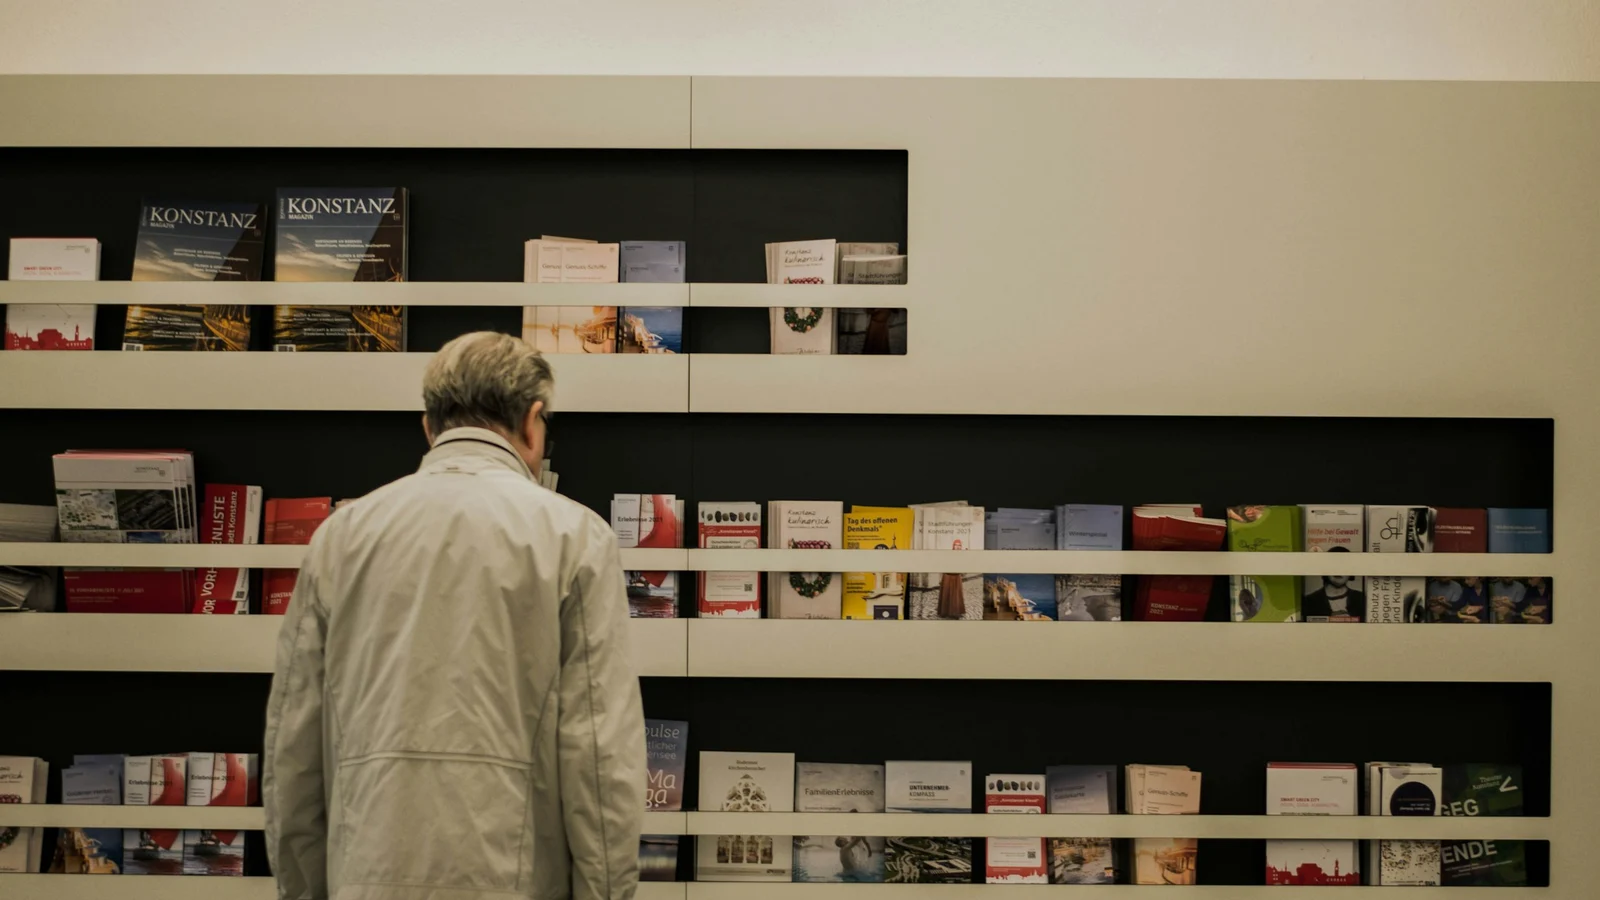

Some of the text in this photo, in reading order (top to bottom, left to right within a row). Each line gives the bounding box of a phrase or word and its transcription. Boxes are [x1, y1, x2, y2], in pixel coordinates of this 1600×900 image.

[287, 197, 396, 214] KONSTANZ
[150, 206, 257, 229] KONSTANZ
[150, 221, 175, 229] MAGAZIN
[228, 491, 238, 530] Konstanz
[1150, 602, 1179, 610] KONSTANZ
[805, 788, 875, 796] FamilienErlebnisse
